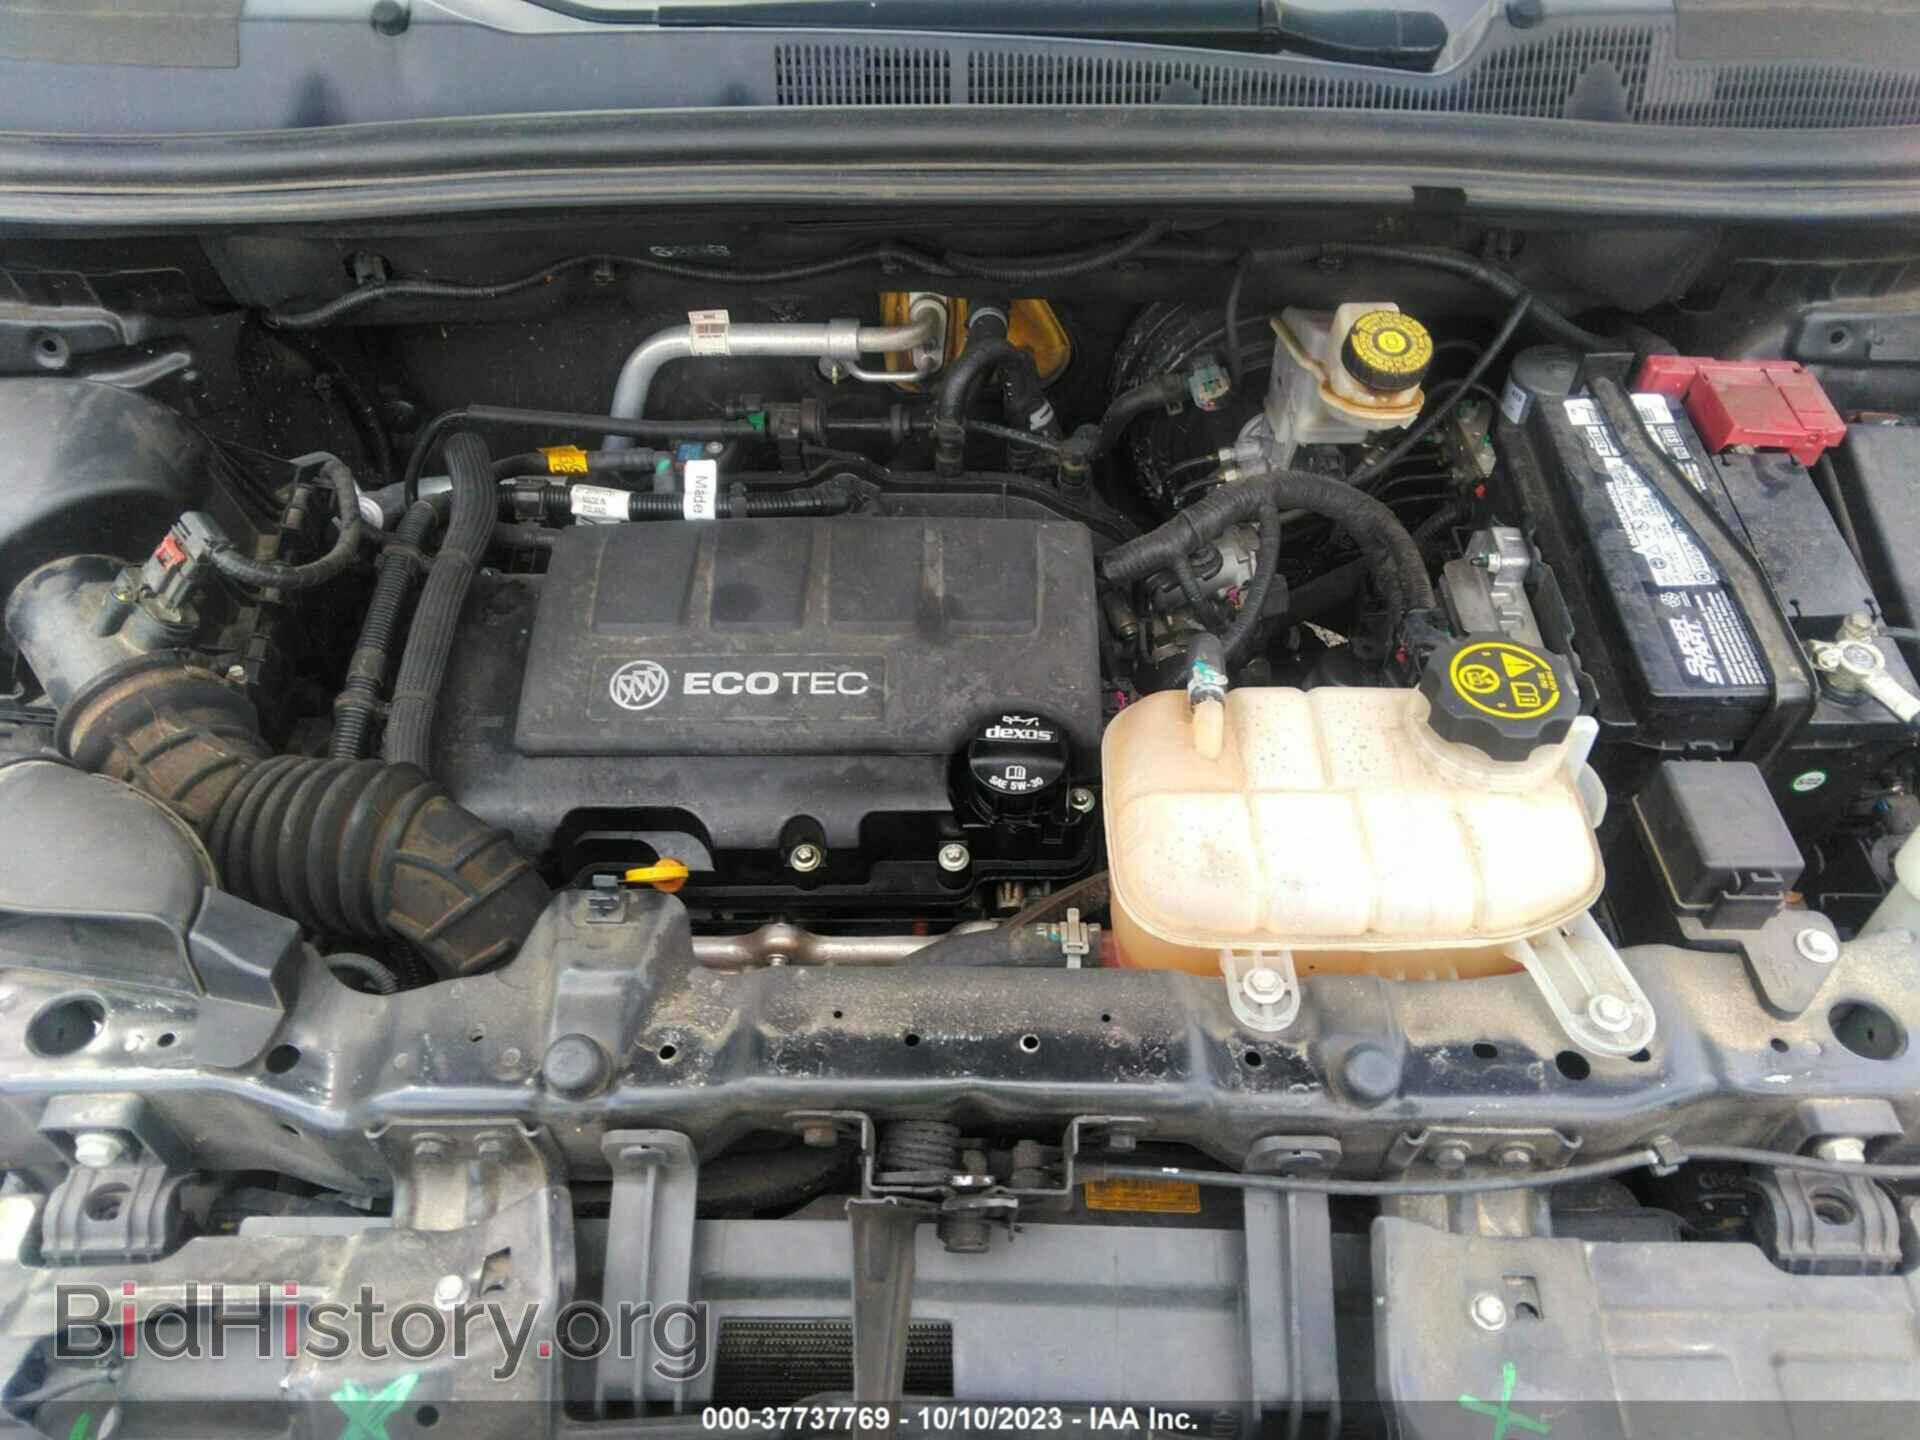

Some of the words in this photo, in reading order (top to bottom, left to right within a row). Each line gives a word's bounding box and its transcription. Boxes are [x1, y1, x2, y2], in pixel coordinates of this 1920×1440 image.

[1669, 615, 1700, 676] SUPER
[1688, 621, 1725, 685] START
[682, 671, 869, 696] ECOTEC
[985, 725, 1054, 741] dexos
[988, 775, 1008, 790] SAE
[1010, 776, 1044, 791] 5W-30
